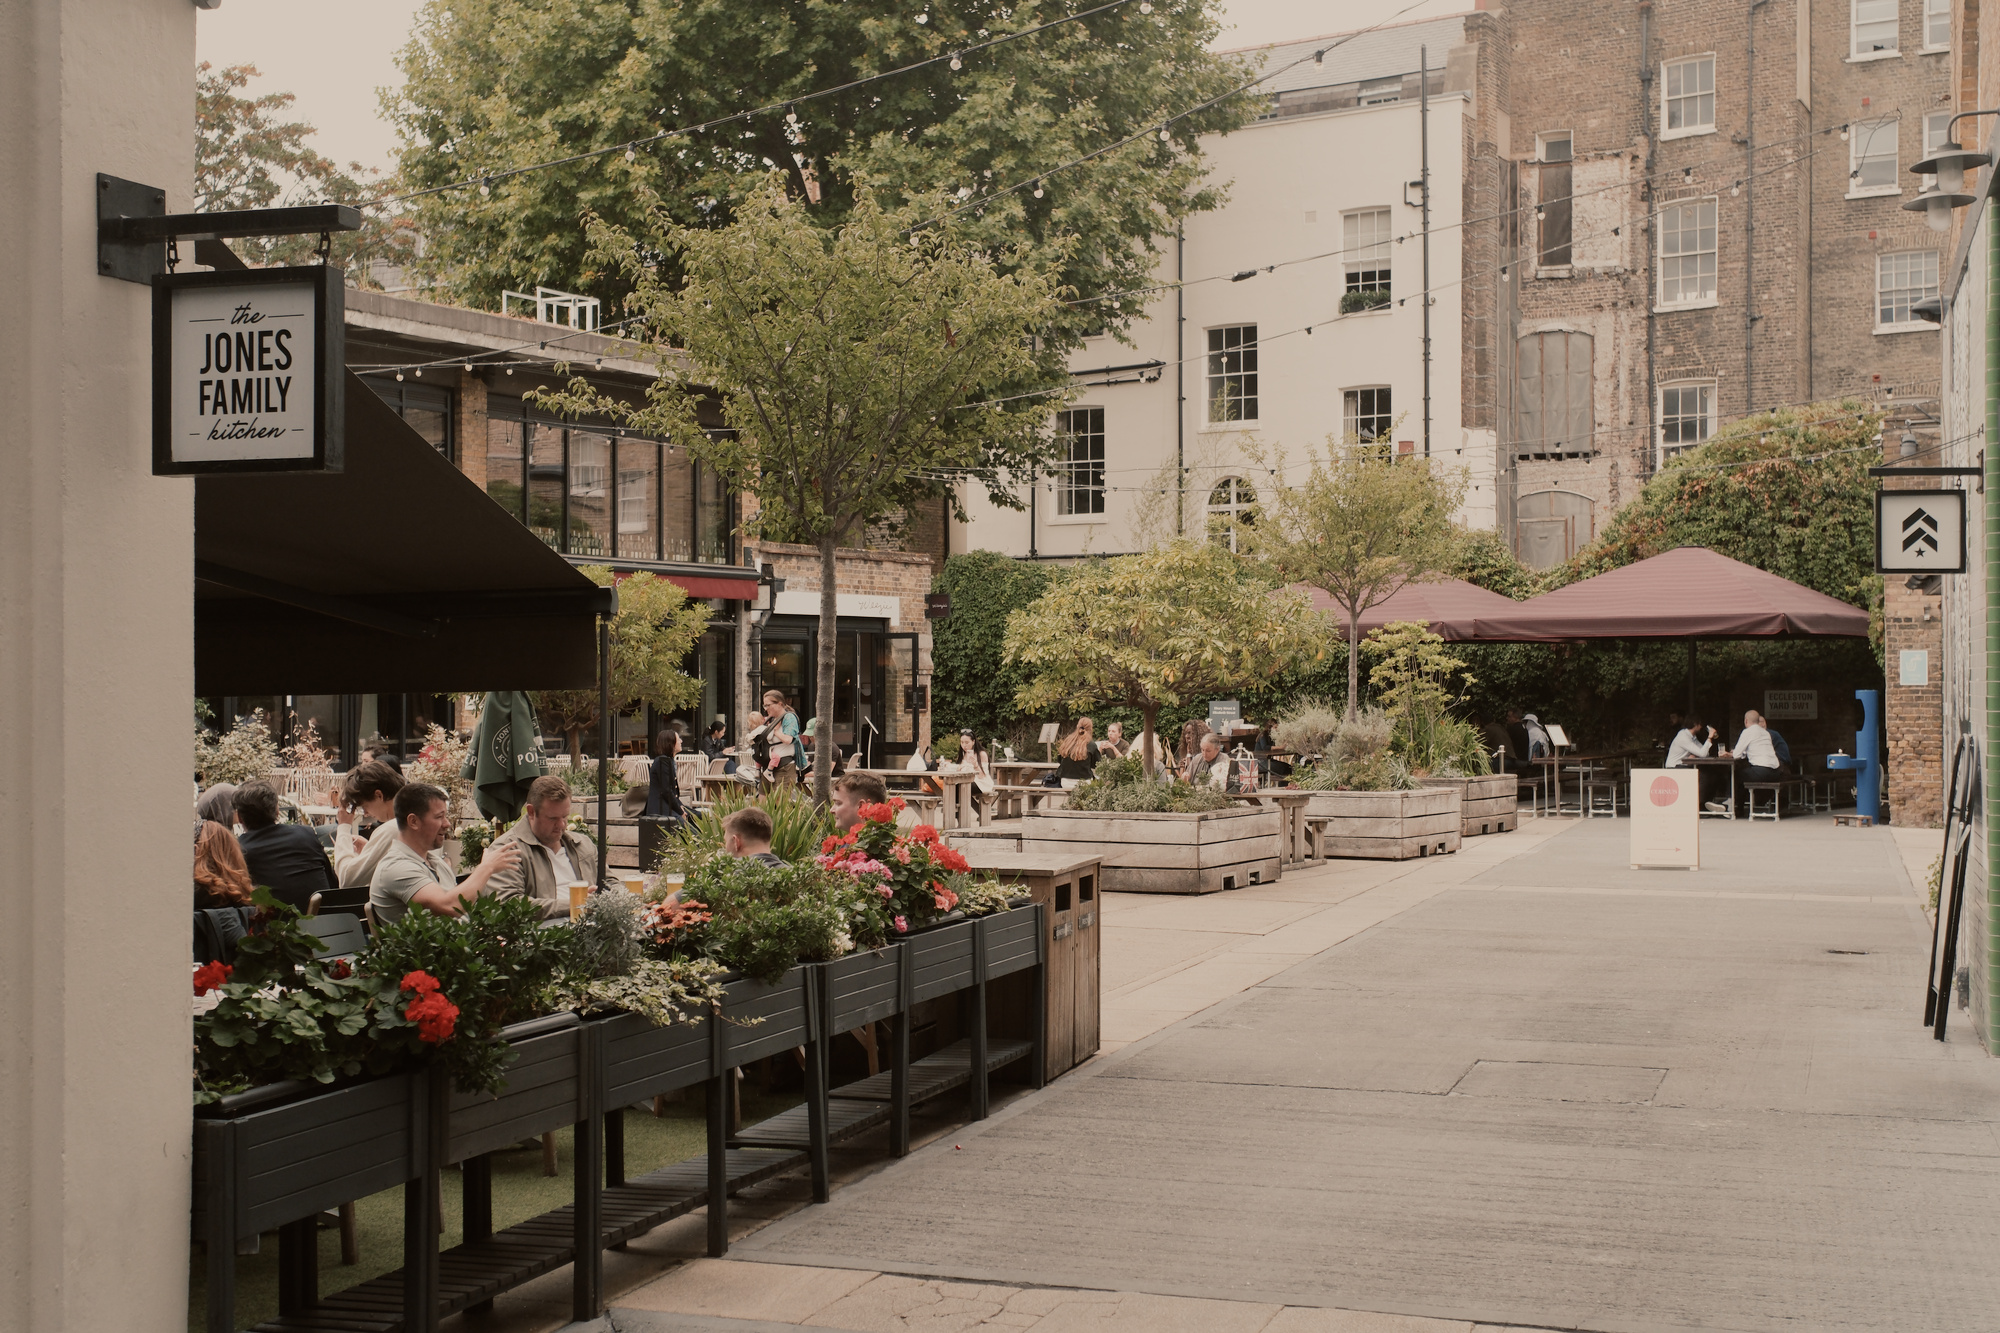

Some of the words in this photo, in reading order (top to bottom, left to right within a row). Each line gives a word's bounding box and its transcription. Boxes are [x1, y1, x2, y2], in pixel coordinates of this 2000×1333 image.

[231, 302, 267, 325] the
[199, 329, 292, 374] JONES
[199, 376, 292, 416] FAMILY
[207, 417, 286, 441] kitchen
[1769, 692, 1813, 701] ECCLESTON
[1769, 701, 1790, 710] YARD
[1791, 701, 1809, 710] SW1
[496, 725, 512, 743] JON
